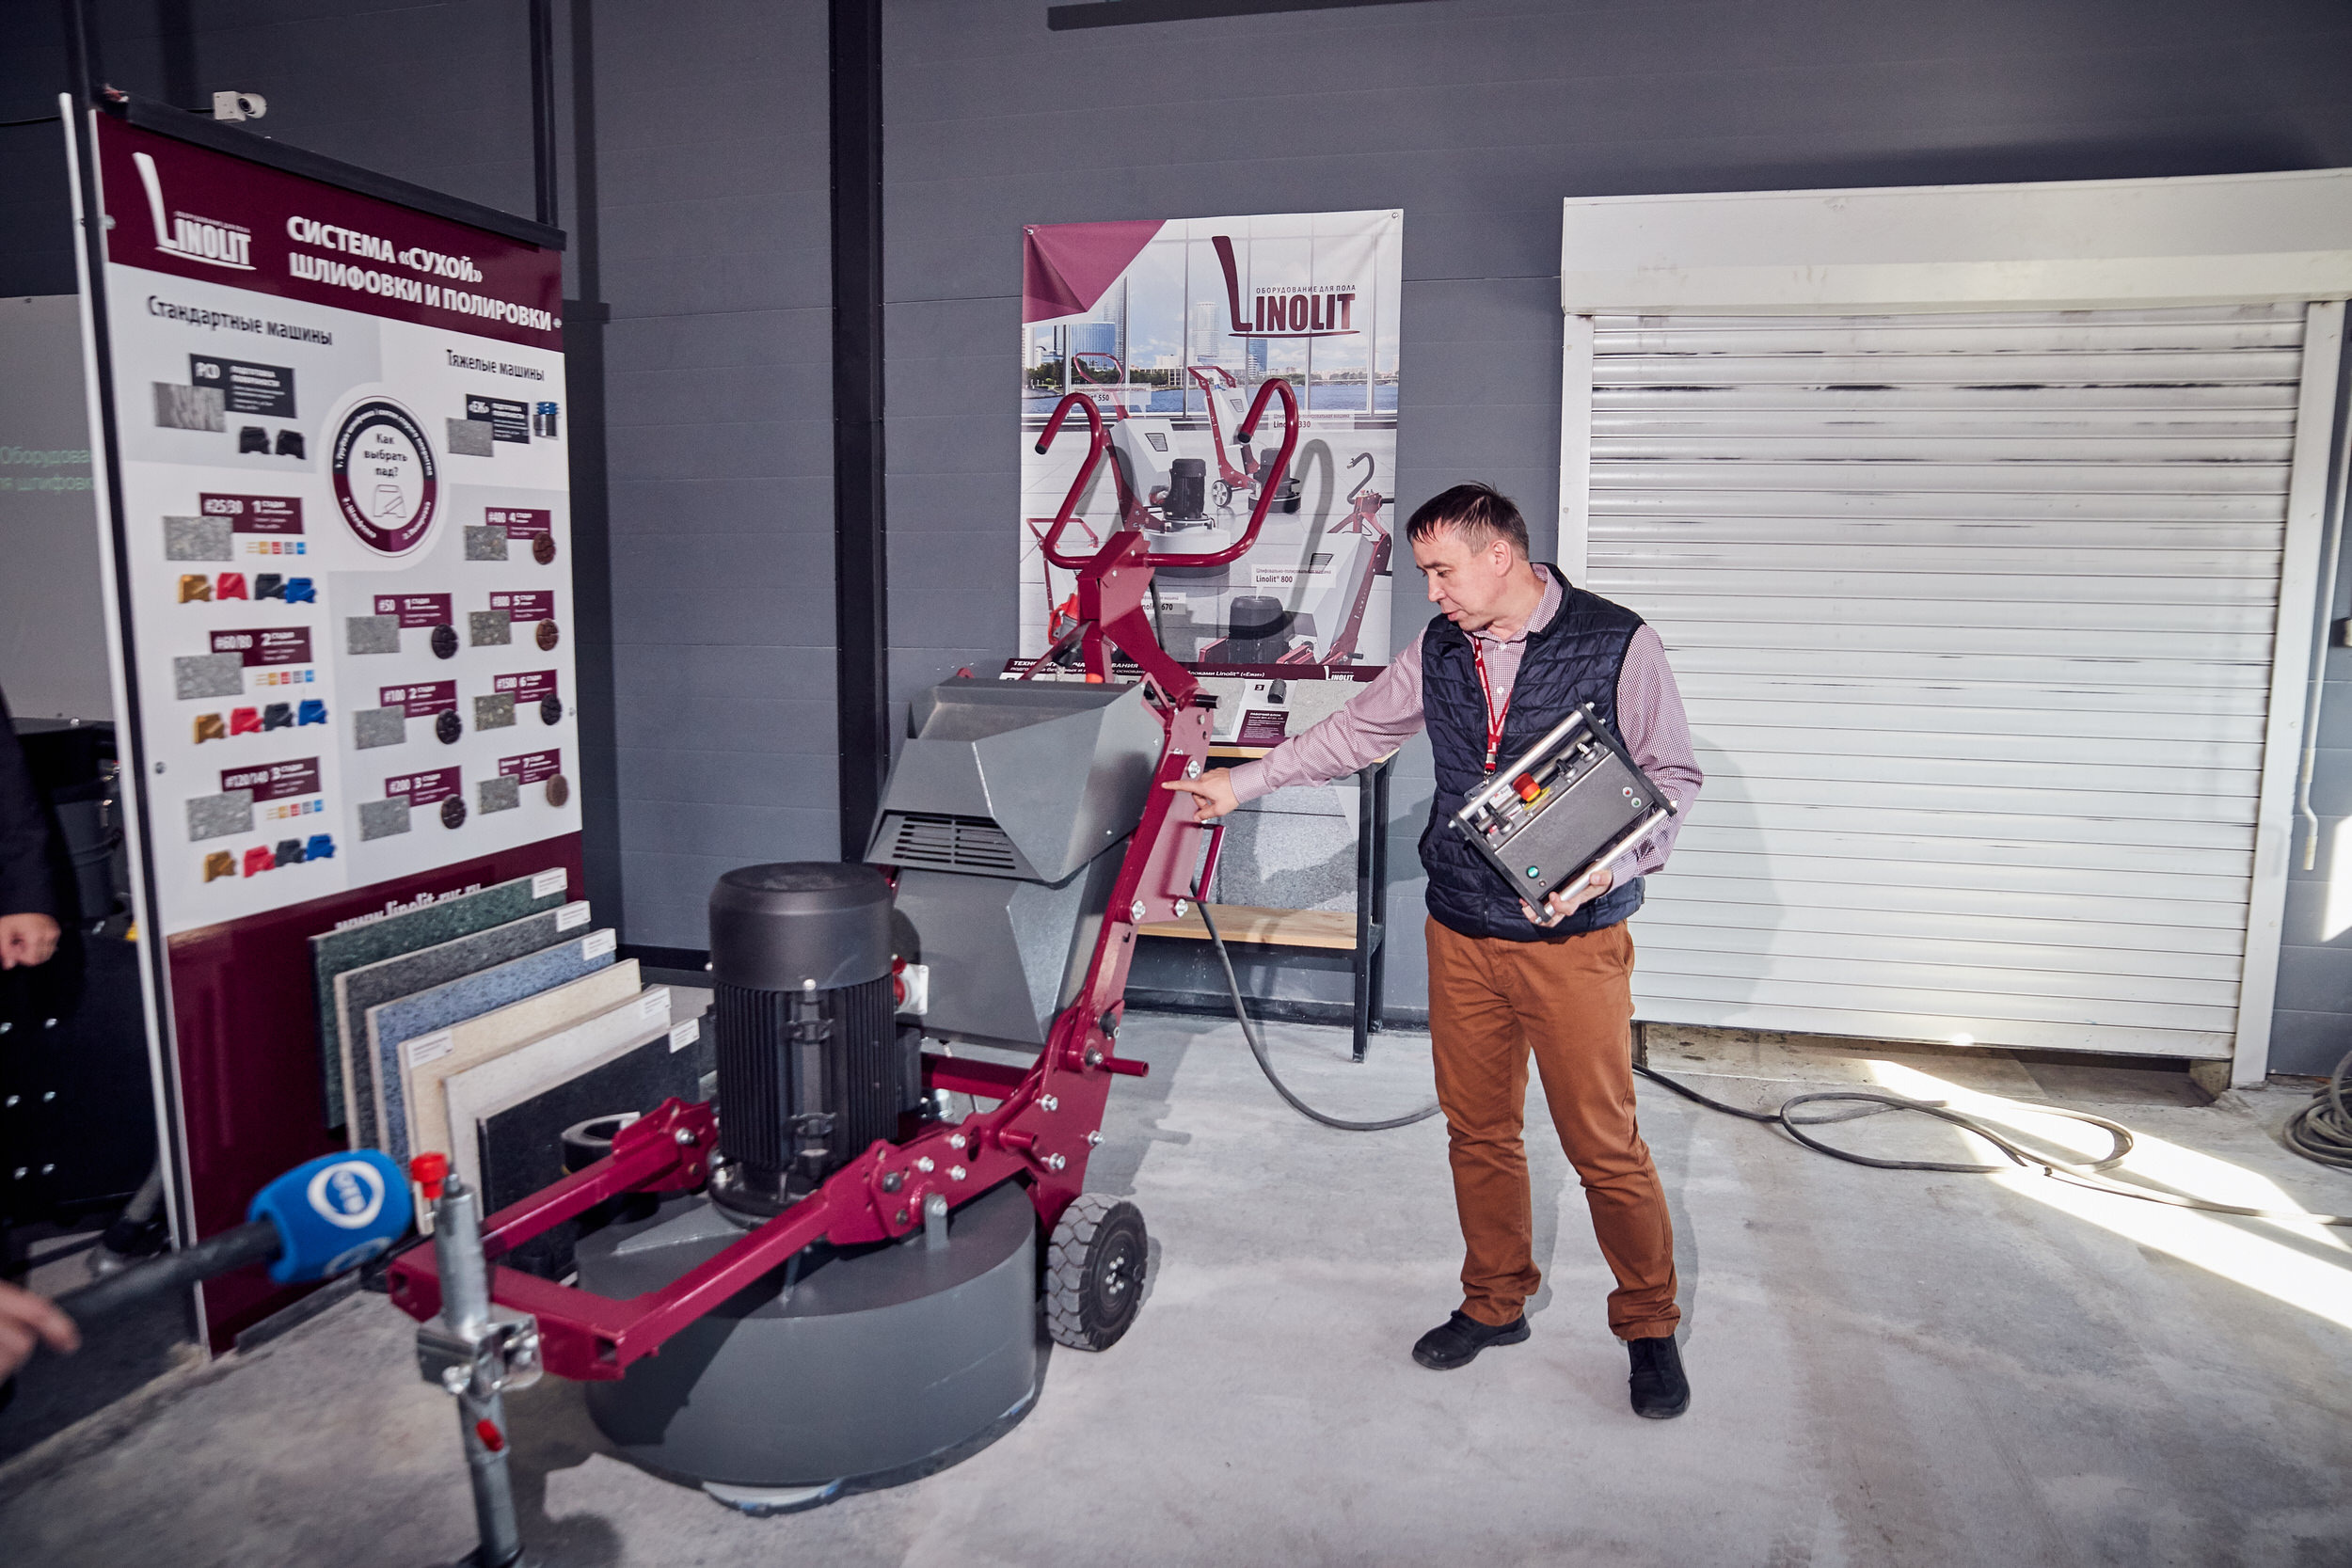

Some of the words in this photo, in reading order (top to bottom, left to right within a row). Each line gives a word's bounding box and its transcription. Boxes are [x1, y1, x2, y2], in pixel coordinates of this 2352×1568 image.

[287, 215, 396, 263] СИСТЕМА
[397, 246, 483, 282] «СУХОЙ»
[1212, 235, 1356, 331] LINOLIT
[1256, 286, 1317, 294] ОБОРУДОВАНИЕ
[1319, 285, 1334, 293] ДЛЯ
[1336, 284, 1356, 293] ПОЛА
[289, 252, 422, 303] ШЛИФОВКИ
[424, 284, 440, 306] И
[442, 288, 552, 331] ПОЛИРОВКИ
[147, 295, 262, 335] Стандартные
[266, 320, 332, 345] машины
[446, 349, 497, 373] Тяжелые
[500, 362, 545, 381] машины
[376, 433, 395, 444] Как
[363, 450, 408, 462] выбрать
[251, 500, 262, 514] 1
[508, 512, 516, 523] 4
[404, 598, 411, 610] 1
[513, 595, 520, 606] 5
[260, 632, 271, 646] 2
[518, 676, 527, 688] 6
[408, 688, 417, 700] 2
[270, 767, 281, 781] 3
[414, 777, 421, 789] 3
